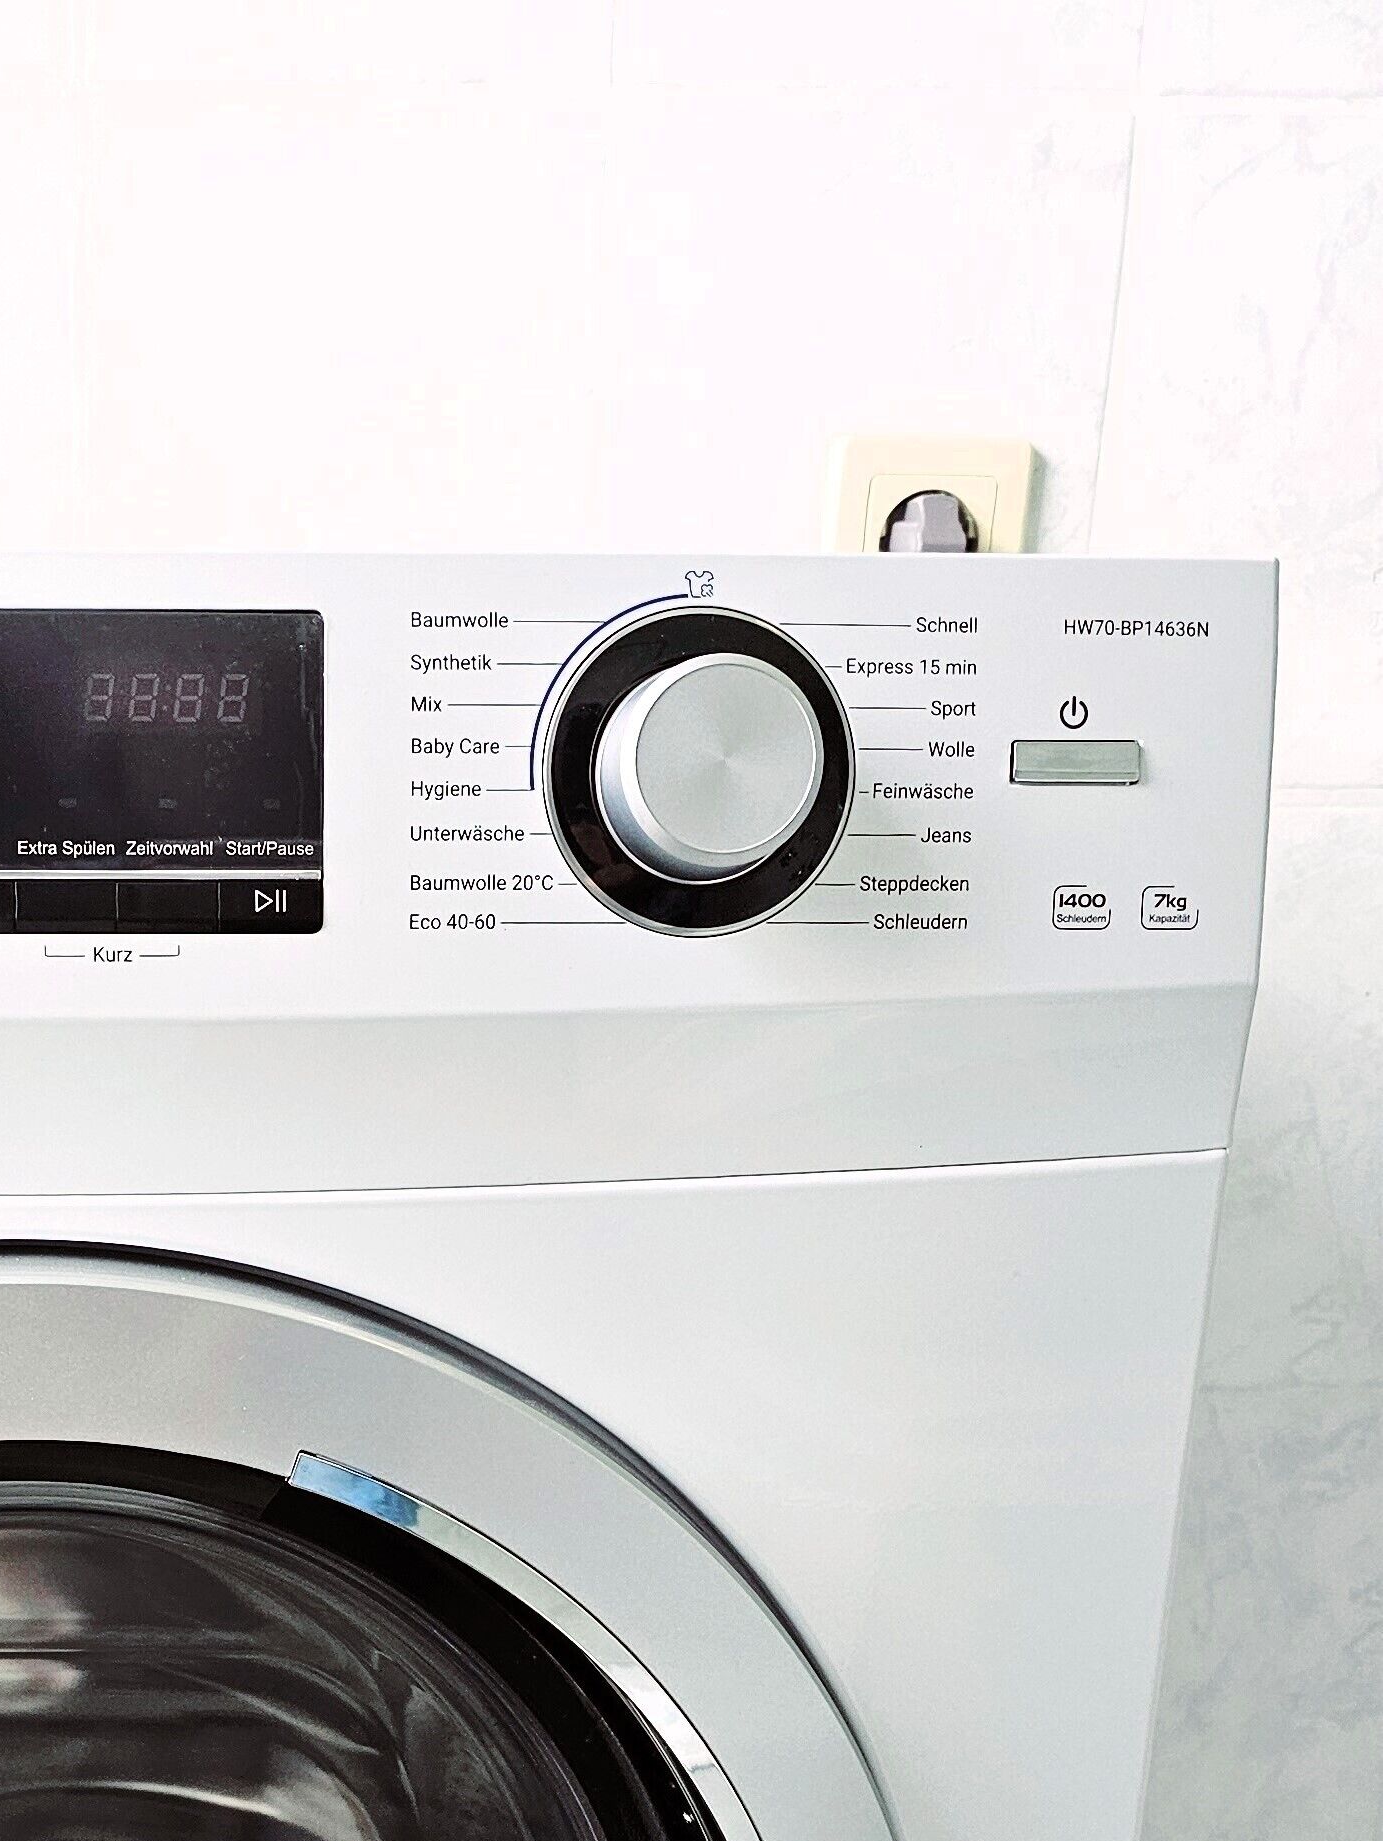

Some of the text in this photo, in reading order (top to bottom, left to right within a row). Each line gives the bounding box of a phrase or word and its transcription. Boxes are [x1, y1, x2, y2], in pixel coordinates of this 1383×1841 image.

[411, 611, 509, 629] Baumwolle
[916, 616, 978, 634] Schnell
[1064, 619, 1209, 638] HW70-BP14636N
[410, 653, 492, 675] Synthetik
[846, 657, 977, 679] Express 15 min
[411, 695, 442, 713] Mix
[930, 700, 976, 721] Sport
[411, 737, 500, 759] Baby Care
[928, 740, 975, 758] Wolle
[411, 780, 482, 801] Hygiene
[872, 782, 974, 800] Feinwäsche
[410, 824, 525, 842] Unterwäsche
[920, 826, 972, 844] Jeans
[17, 840, 116, 859] Extra Spülen
[125, 840, 214, 856] Zeitvorwahl
[225, 840, 314, 856] Start/Pause
[410, 873, 554, 891] Baumwolle 20°C
[859, 874, 970, 896] Steppdecken
[1058, 893, 1107, 909] 1400
[1154, 893, 1187, 912] 7kg
[409, 913, 496, 930] Eco 40-60
[873, 912, 968, 930] Schleudern
[1056, 913, 1107, 924] Schleudern
[1148, 913, 1191, 925] Kapazität
[93, 946, 133, 963] Kurz
